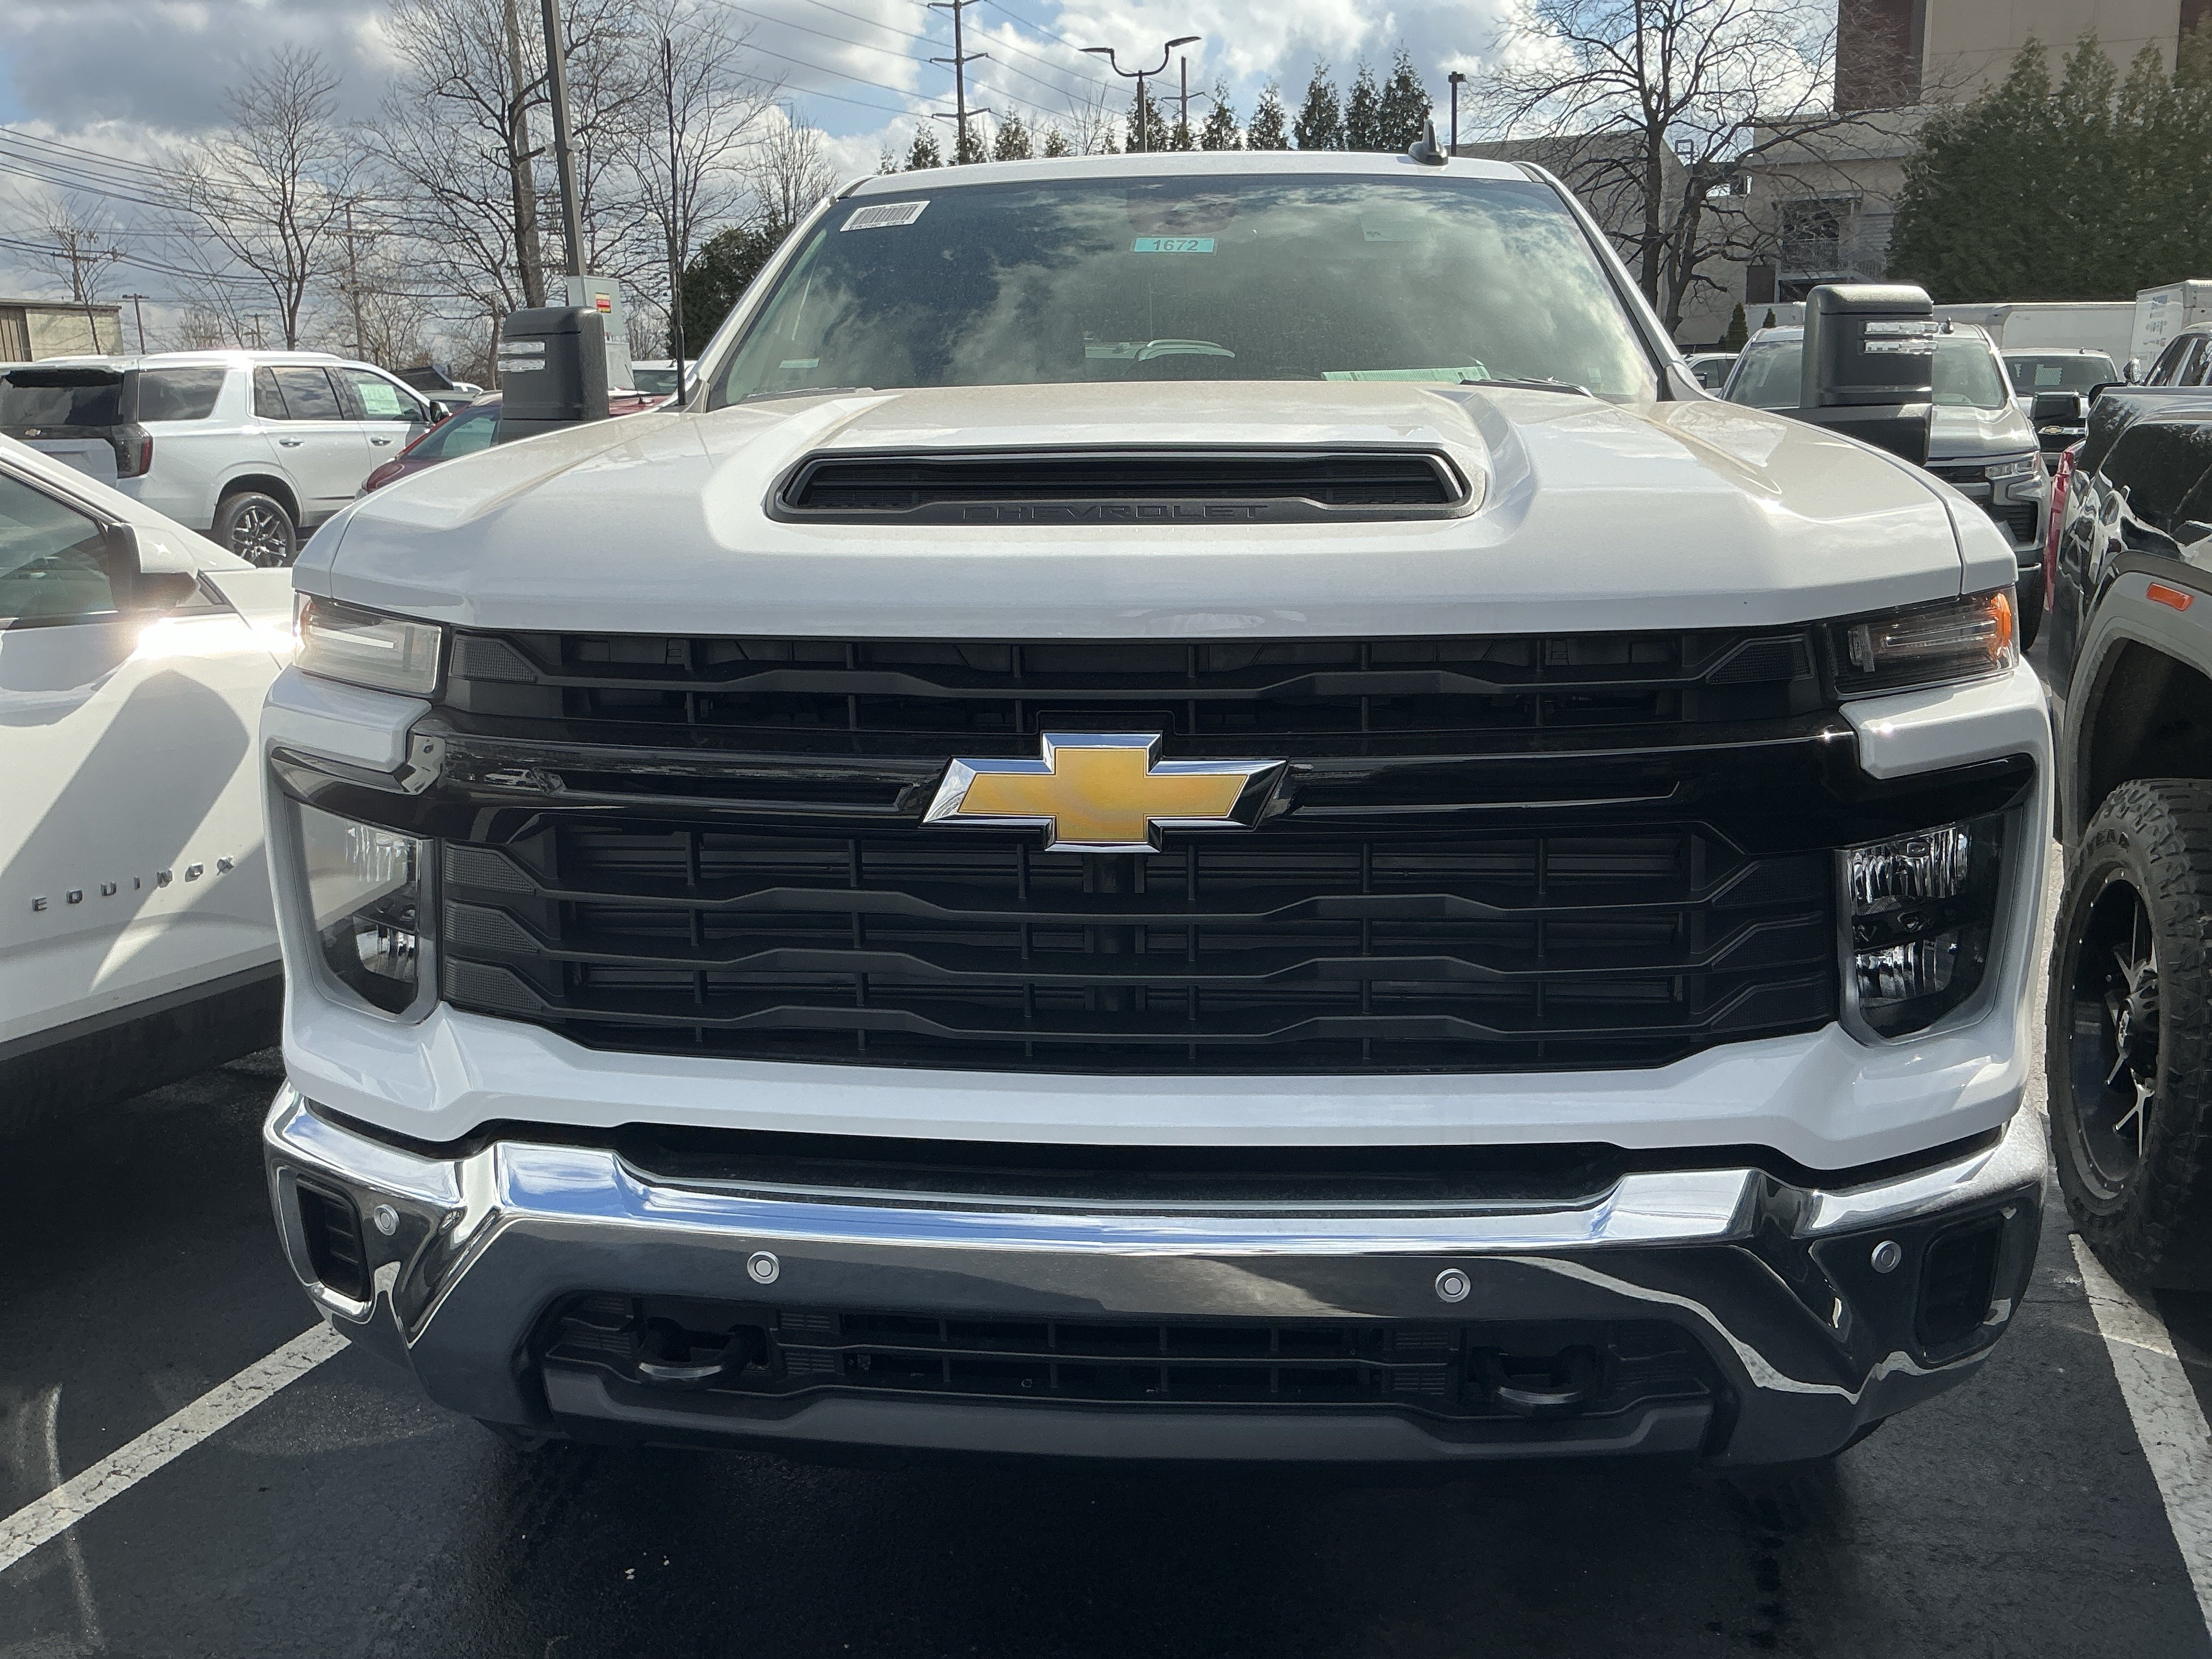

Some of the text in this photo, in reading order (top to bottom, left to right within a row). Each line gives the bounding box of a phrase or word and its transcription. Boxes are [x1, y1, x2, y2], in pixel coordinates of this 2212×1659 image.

[1153, 240, 1198, 251] 1672
[963, 506, 1268, 520] CHEVROLET
[32, 856, 234, 911] EQUINOX
